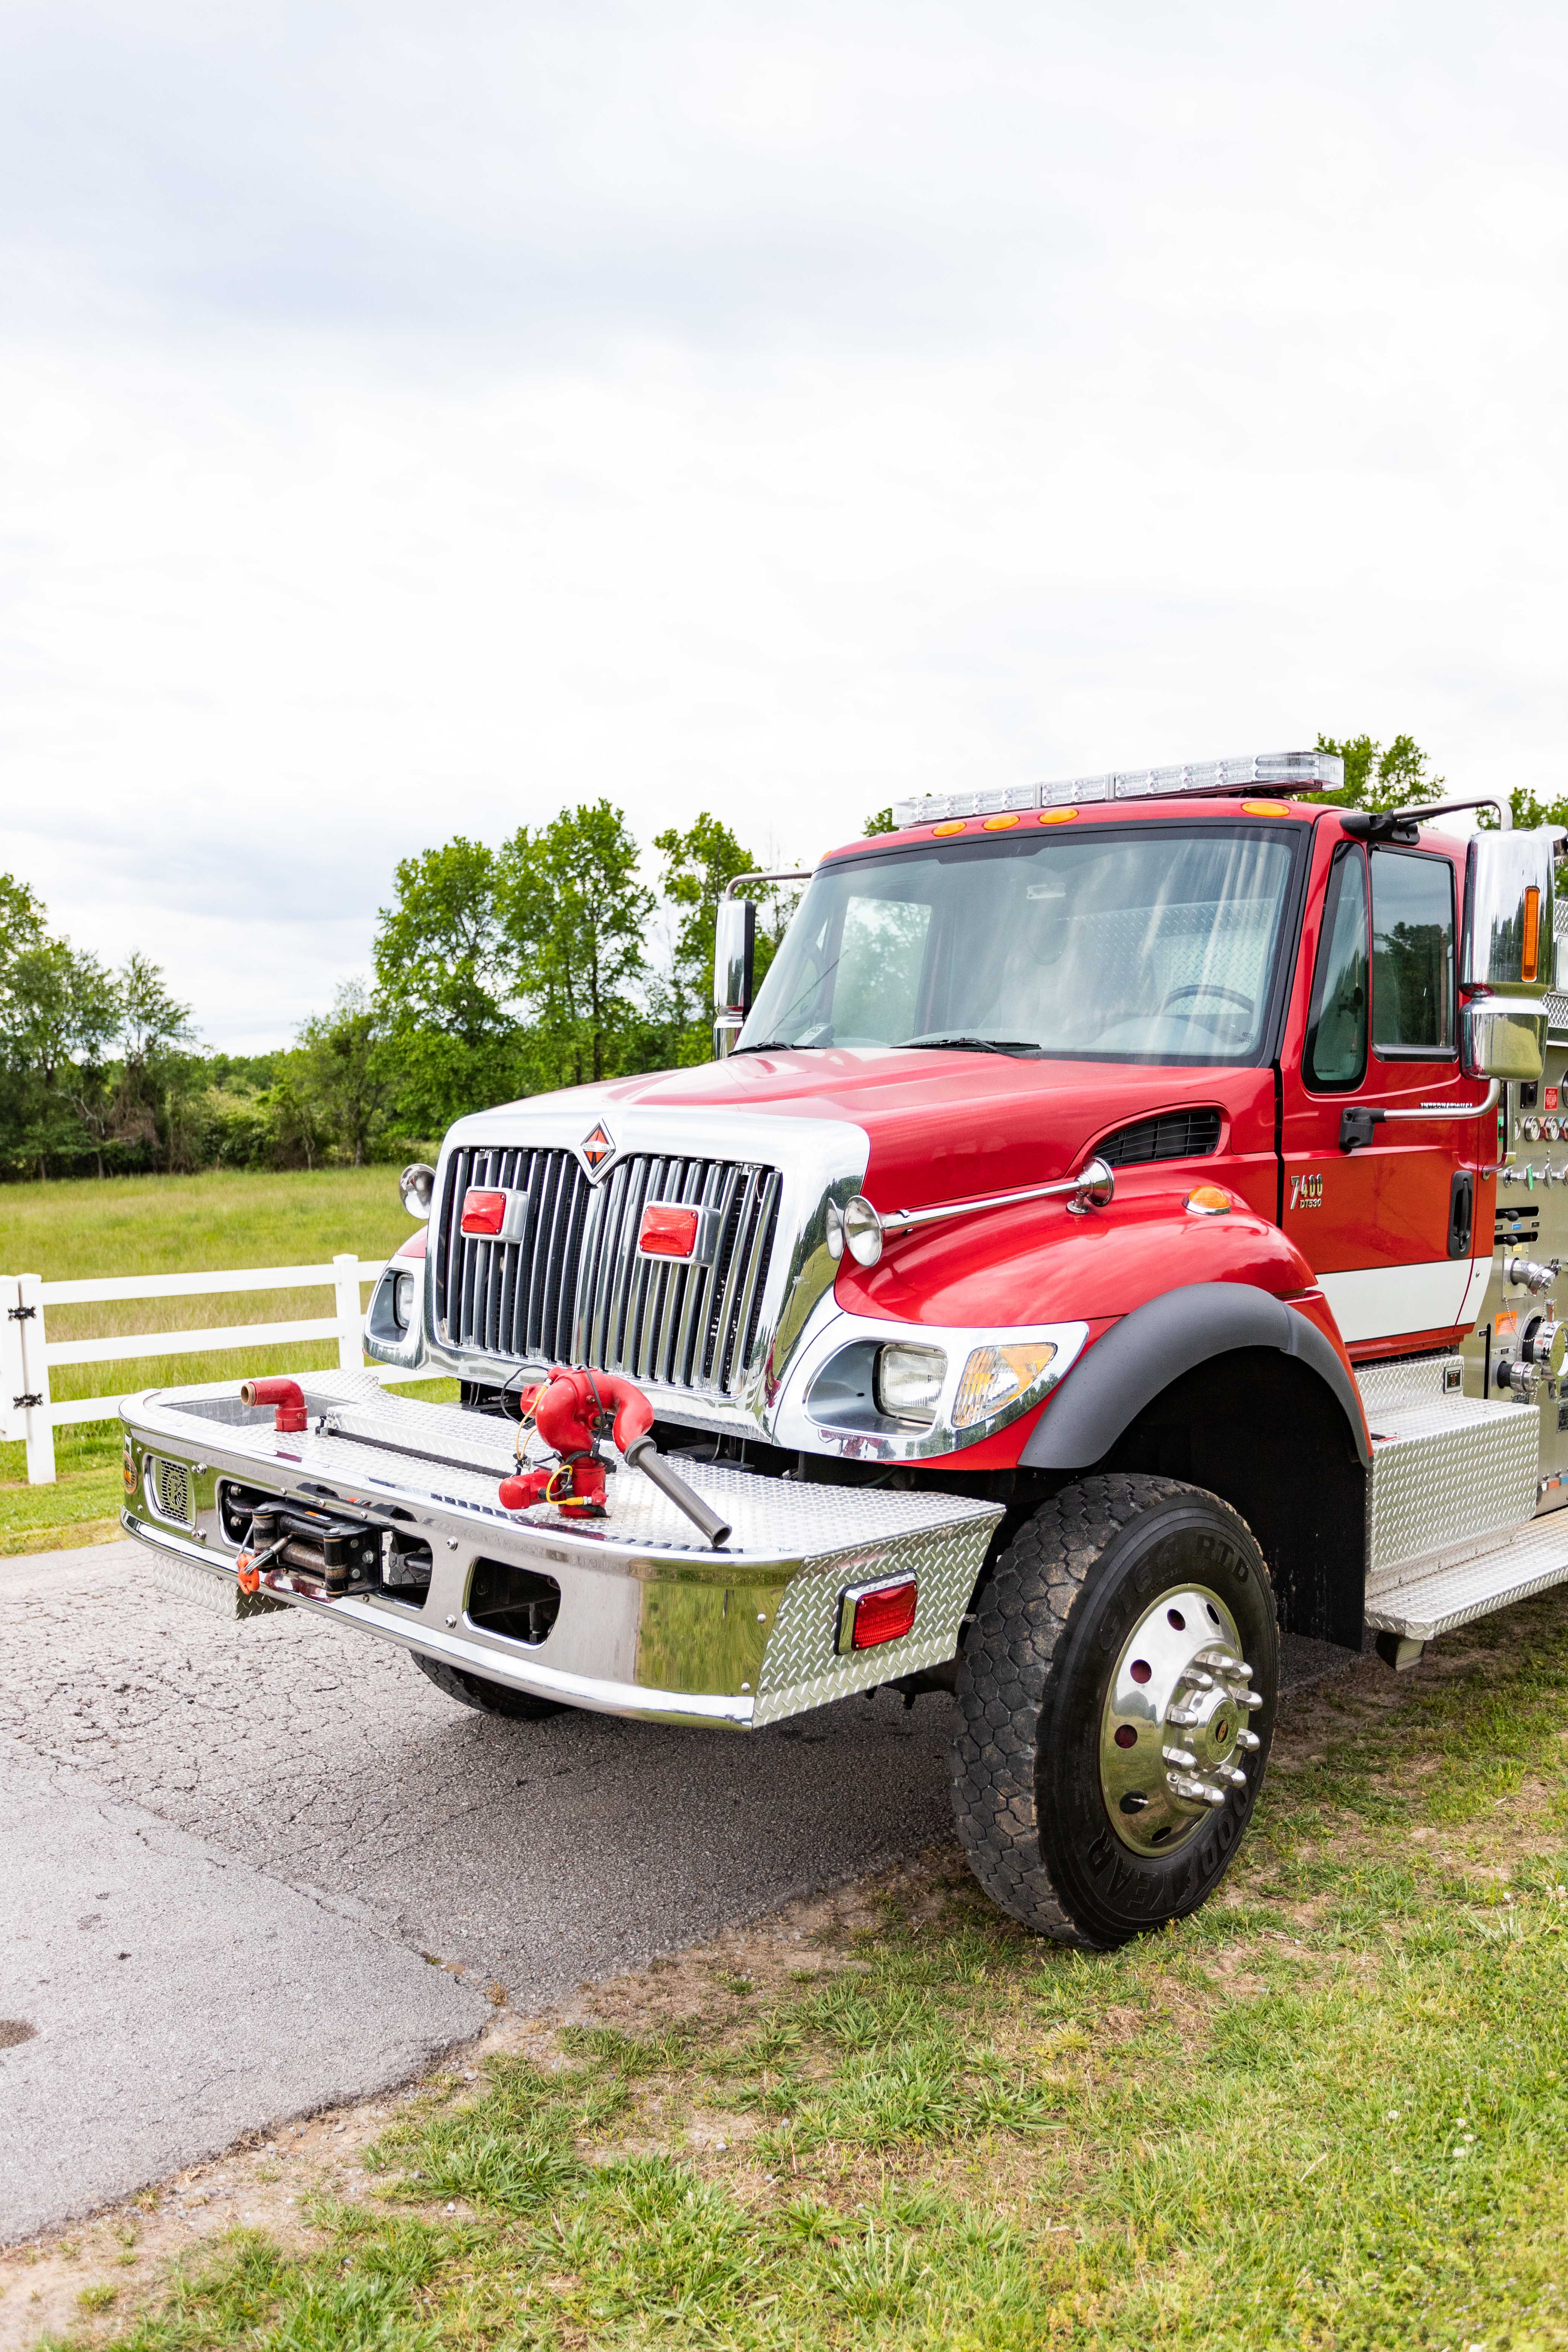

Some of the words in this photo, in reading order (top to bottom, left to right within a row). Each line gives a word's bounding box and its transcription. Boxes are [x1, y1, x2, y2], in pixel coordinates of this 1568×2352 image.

[1290, 1174, 1323, 1210] 7400
[1300, 1198, 1322, 1209] DT530
[1194, 1533, 1250, 1584] RTD
[1087, 1753, 1261, 1911] GOODYEAR
